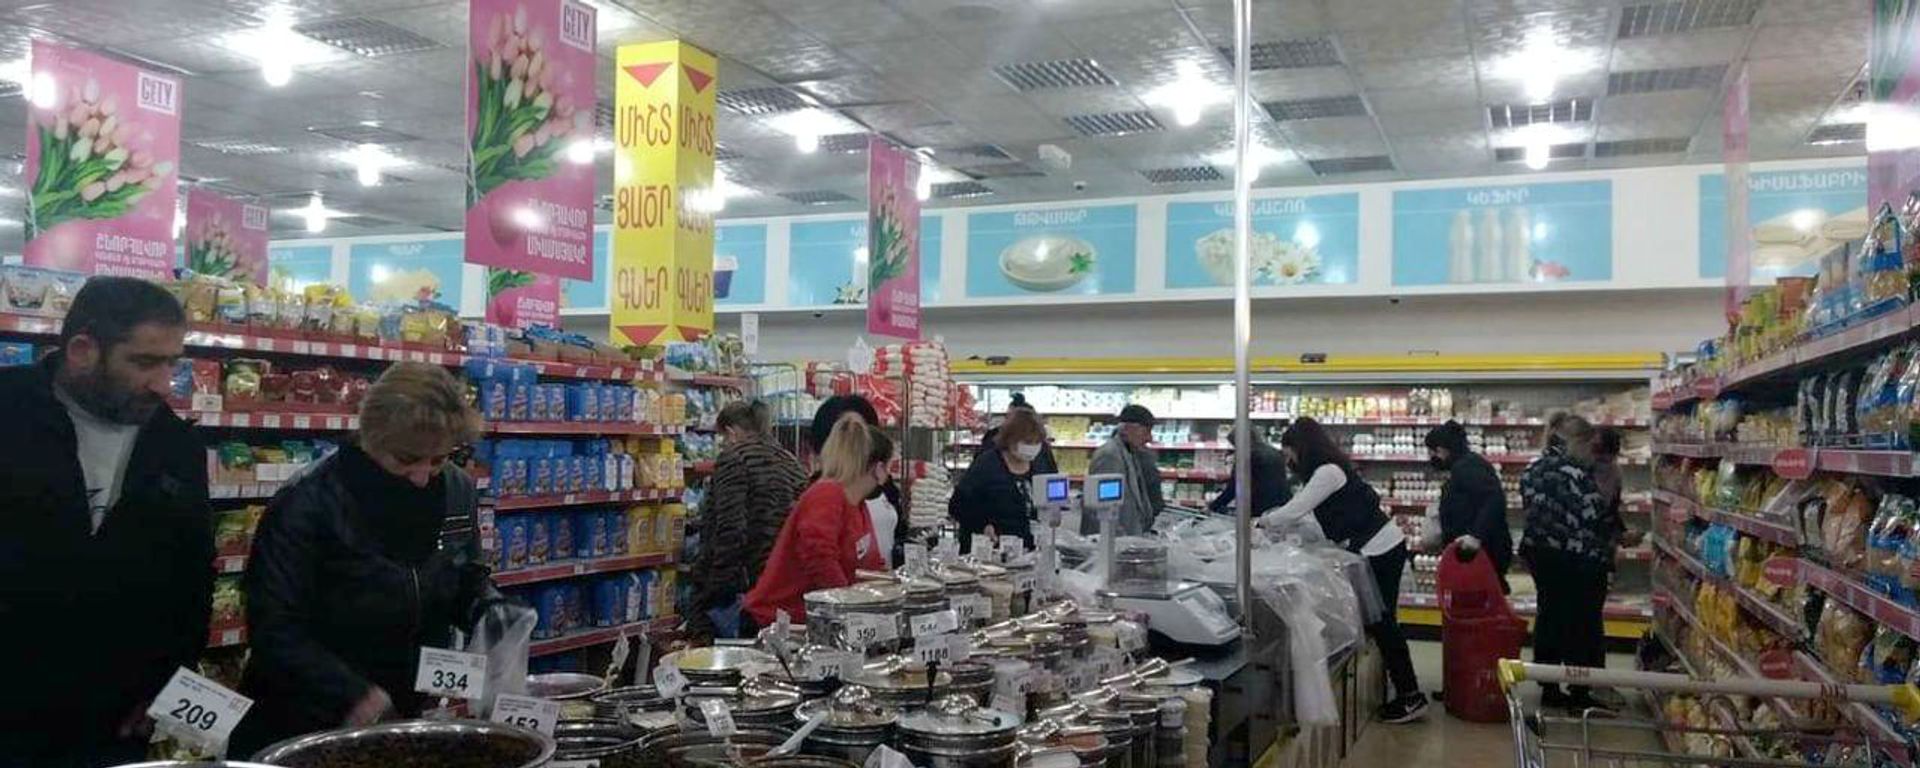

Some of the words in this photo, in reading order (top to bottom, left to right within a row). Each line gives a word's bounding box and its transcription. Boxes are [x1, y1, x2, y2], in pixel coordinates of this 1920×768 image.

[620, 103, 672, 148] ՄԻՇՏ
[681, 104, 714, 157] ՄԻՇՏ
[1747, 170, 1866, 191] ԿԻՍԱՖԱԲՐԻ
[617, 265, 668, 310] ԳՆԵՐ
[677, 266, 711, 314] ԳՆԵՐ
[432, 670, 468, 690] 334
[170, 698, 218, 731] 209
